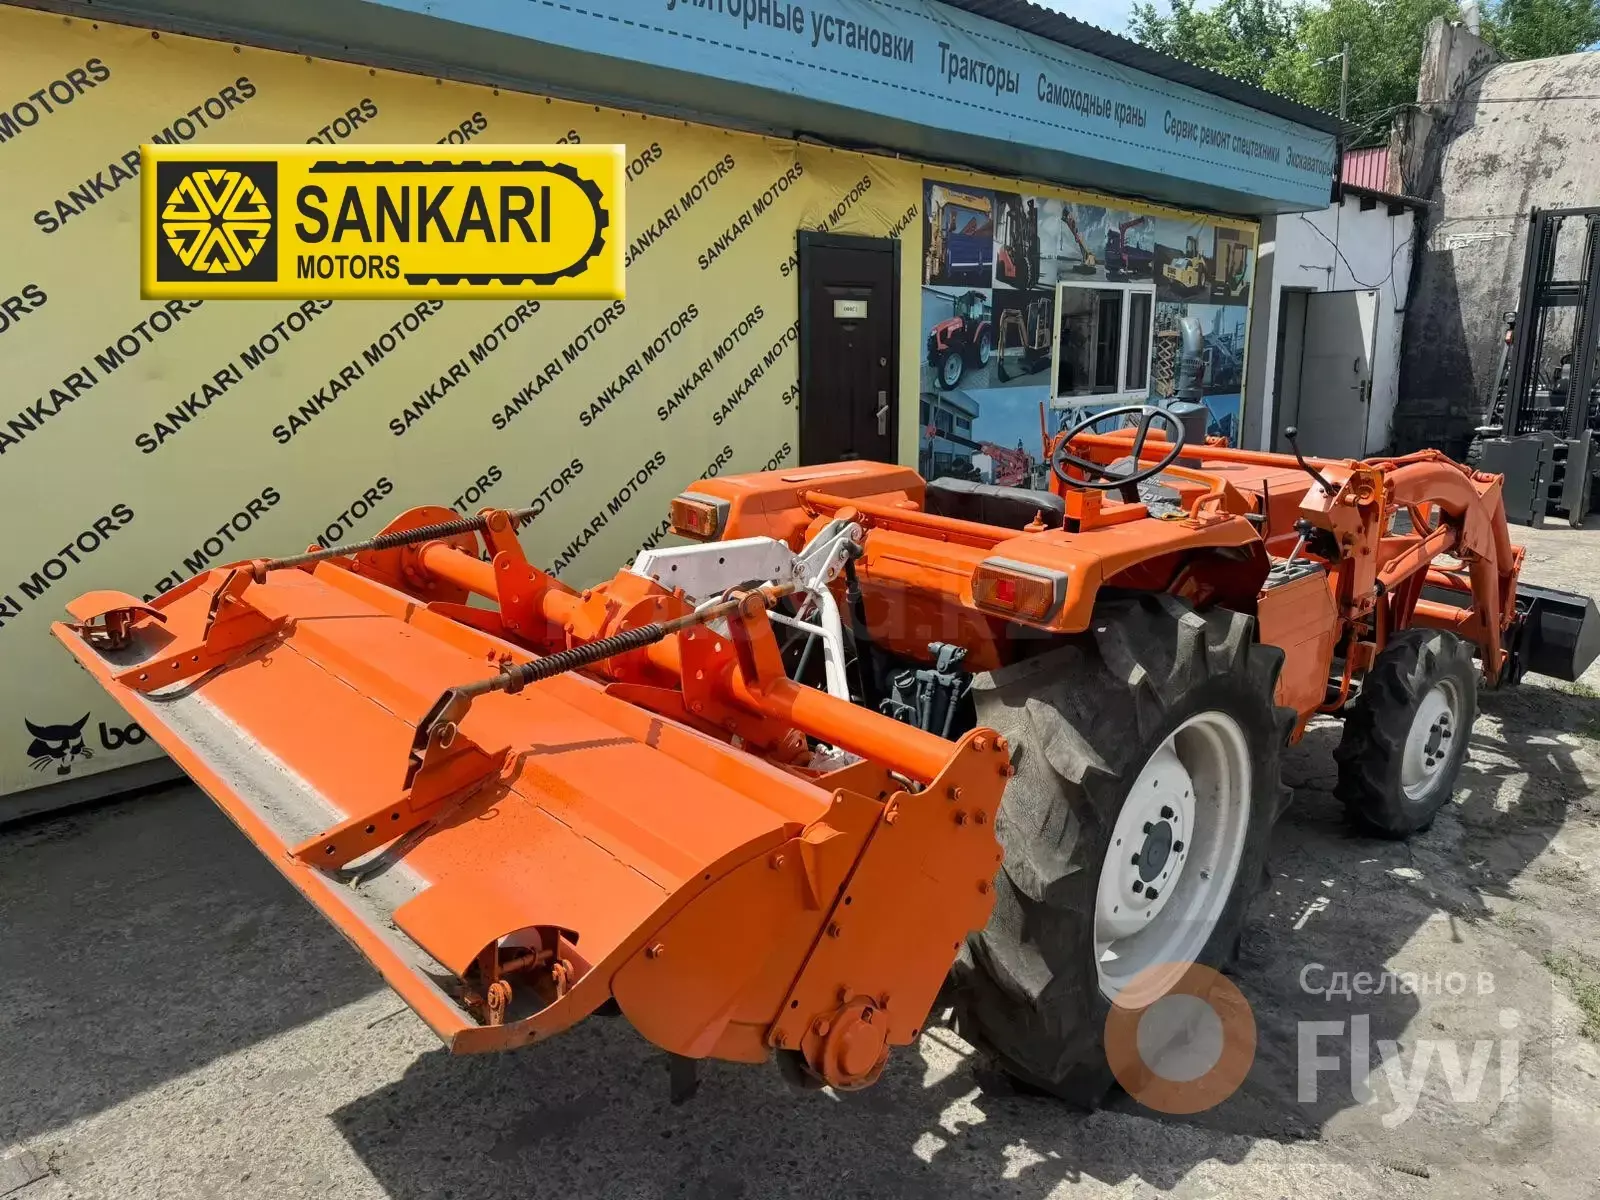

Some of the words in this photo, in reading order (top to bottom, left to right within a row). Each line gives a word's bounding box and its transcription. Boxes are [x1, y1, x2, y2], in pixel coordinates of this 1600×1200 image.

[811, 11, 914, 64] установки
[938, 41, 1020, 97] Тракторы
[1037, 73, 1112, 119] Самоходные
[1114, 101, 1147, 129] краны
[1164, 110, 1199, 143] Сервис
[1199, 126, 1231, 149] ремонт
[1232, 135, 1281, 164] спецтехники
[34, 146, 141, 234] SANKAR
[152, 77, 257, 144] MOTORS
[680, 154, 735, 210] MOTORS
[828, 175, 872, 226] MOTORS
[698, 210, 753, 270] SANKARI
[752, 161, 804, 217] MOTORS
[272, 360, 365, 444] SANKARI
[362, 300, 444, 367] MOTORS
[389, 358, 471, 436] SANKARI
[468, 300, 541, 366] MOTORS
[491, 358, 564, 431] SANKARI
[561, 299, 626, 365] MOTORS
[579, 359, 644, 427] SANKARI
[641, 303, 699, 363] MOTORS
[656, 357, 714, 422] SANKARI
[712, 304, 765, 364] MOTORS
[712, 363, 764, 426] SANKARI
[135, 363, 243, 454] SANKARI
[607, 450, 666, 516] MOTORS
[18, 503, 135, 601] MOTORS
[183, 486, 281, 575] MOTORS
